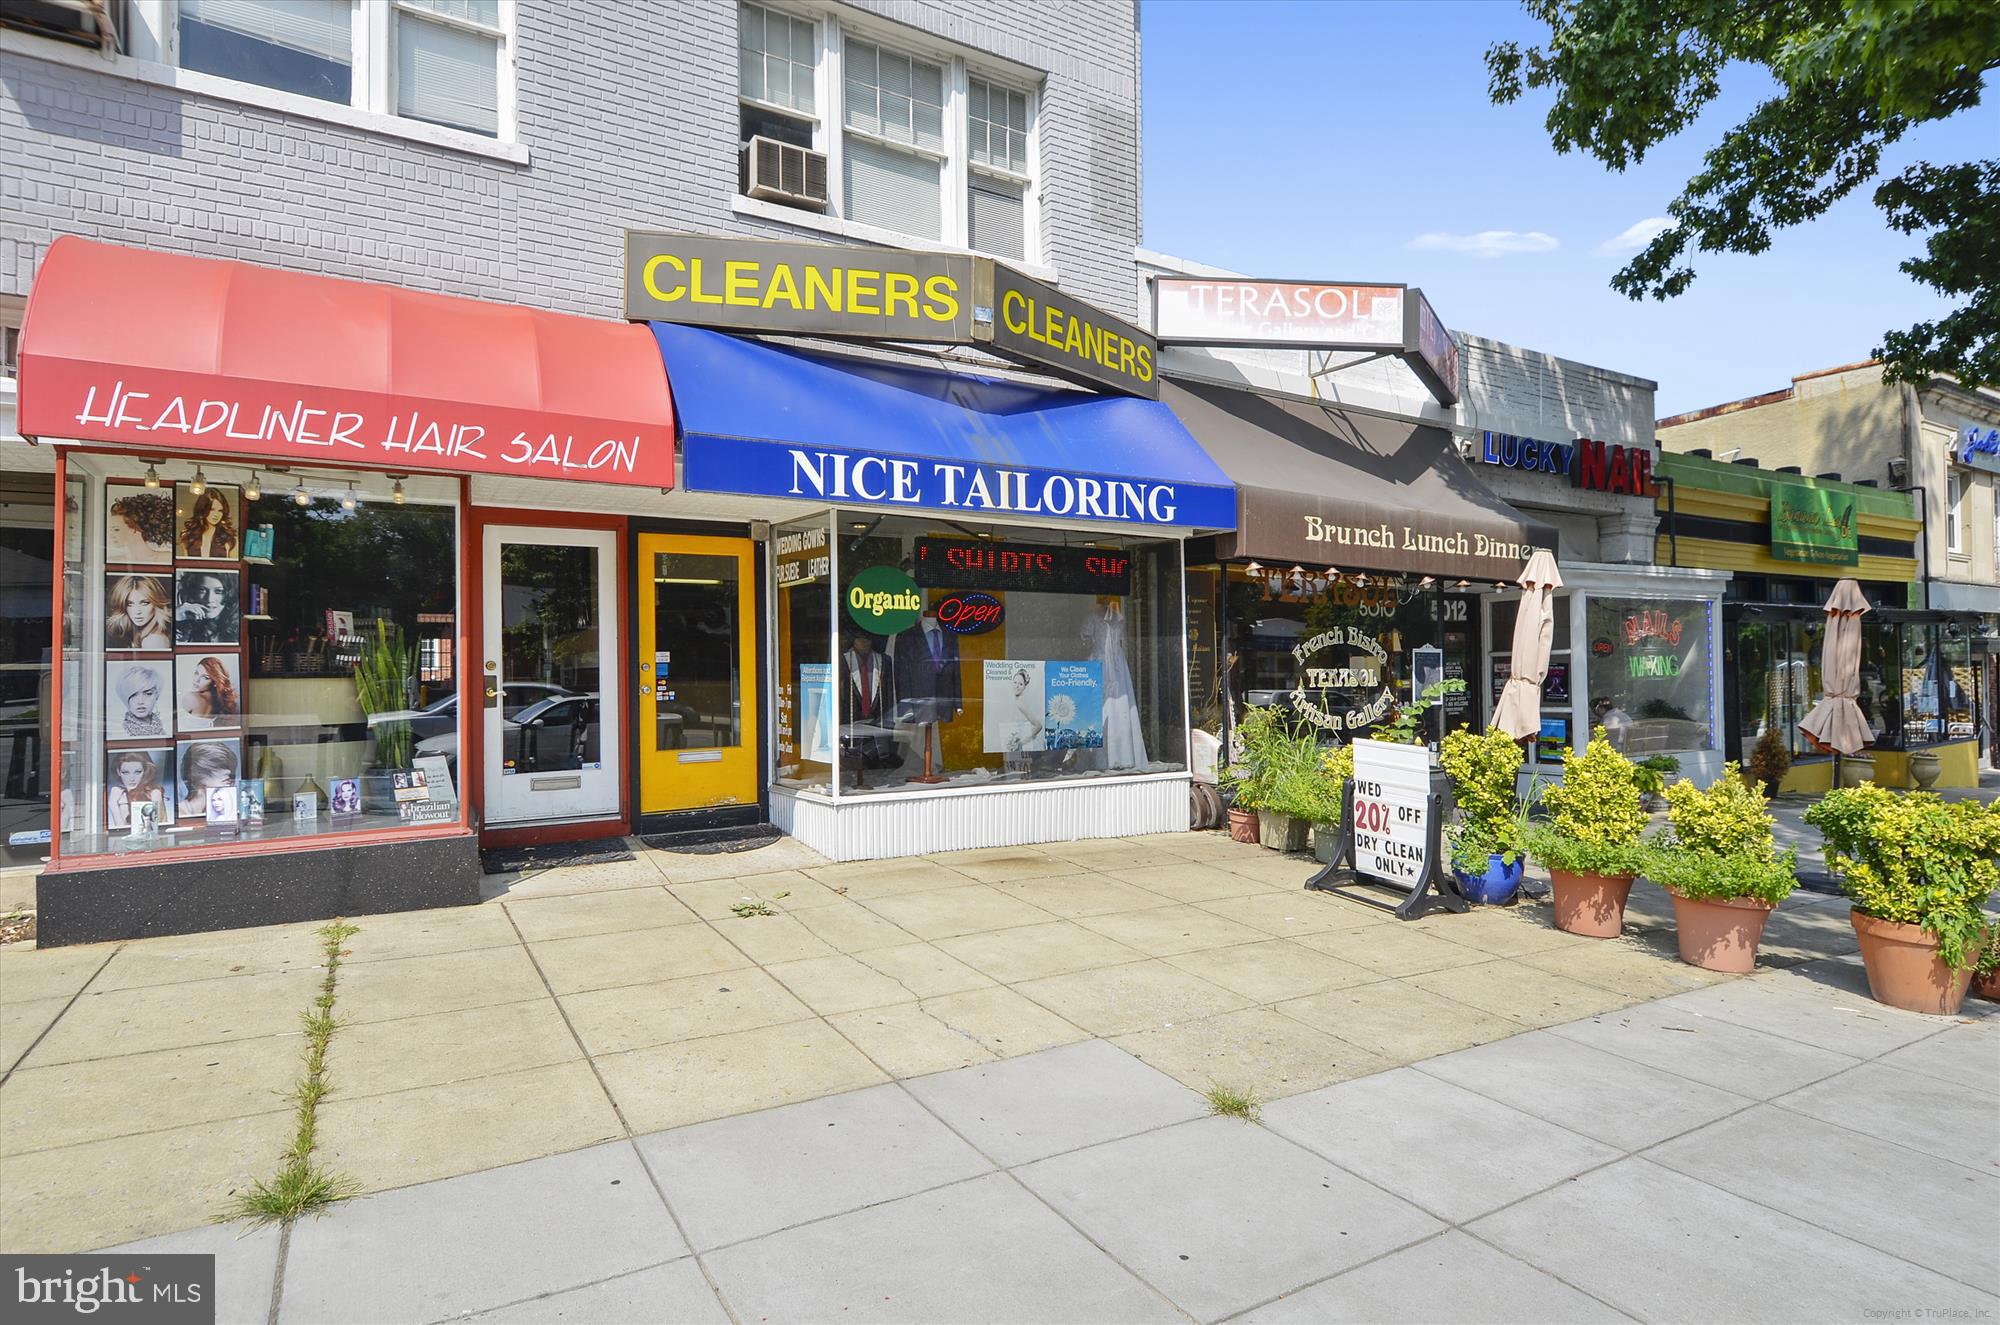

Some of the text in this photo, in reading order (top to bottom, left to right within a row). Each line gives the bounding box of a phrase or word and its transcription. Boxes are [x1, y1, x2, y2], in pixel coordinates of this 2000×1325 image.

[642, 254, 959, 322] CLEANERS
[1190, 284, 1370, 320] TERASOL
[1002, 289, 1153, 383] CLEANERS
[75, 380, 640, 473] HEADLINER HAIR SALON
[1483, 431, 1660, 498] LUCKY NAIL
[787, 449, 1177, 522] NICE TAILORING
[776, 527, 826, 556] WEDDING GOWNS
[1304, 515, 1396, 549] Brunch
[1402, 527, 1469, 556] Lunch
[808, 556, 829, 577] LEATHER
[850, 586, 921, 616] Organic
[937, 598, 1001, 628] Open
[1431, 600, 1467, 621] 5012
[1624, 609, 1683, 647] NAILS
[1292, 626, 1388, 667] French Bistro
[1628, 654, 1680, 677] WAXING
[1357, 780, 1382, 797] WED
[410, 802, 450, 813] brazilian
[412, 811, 449, 821] blowout
[1355, 800, 1421, 835] 20% OFF
[1357, 834, 1423, 863] DRY CLEAN
[1375, 856, 1405, 877] ONLY
